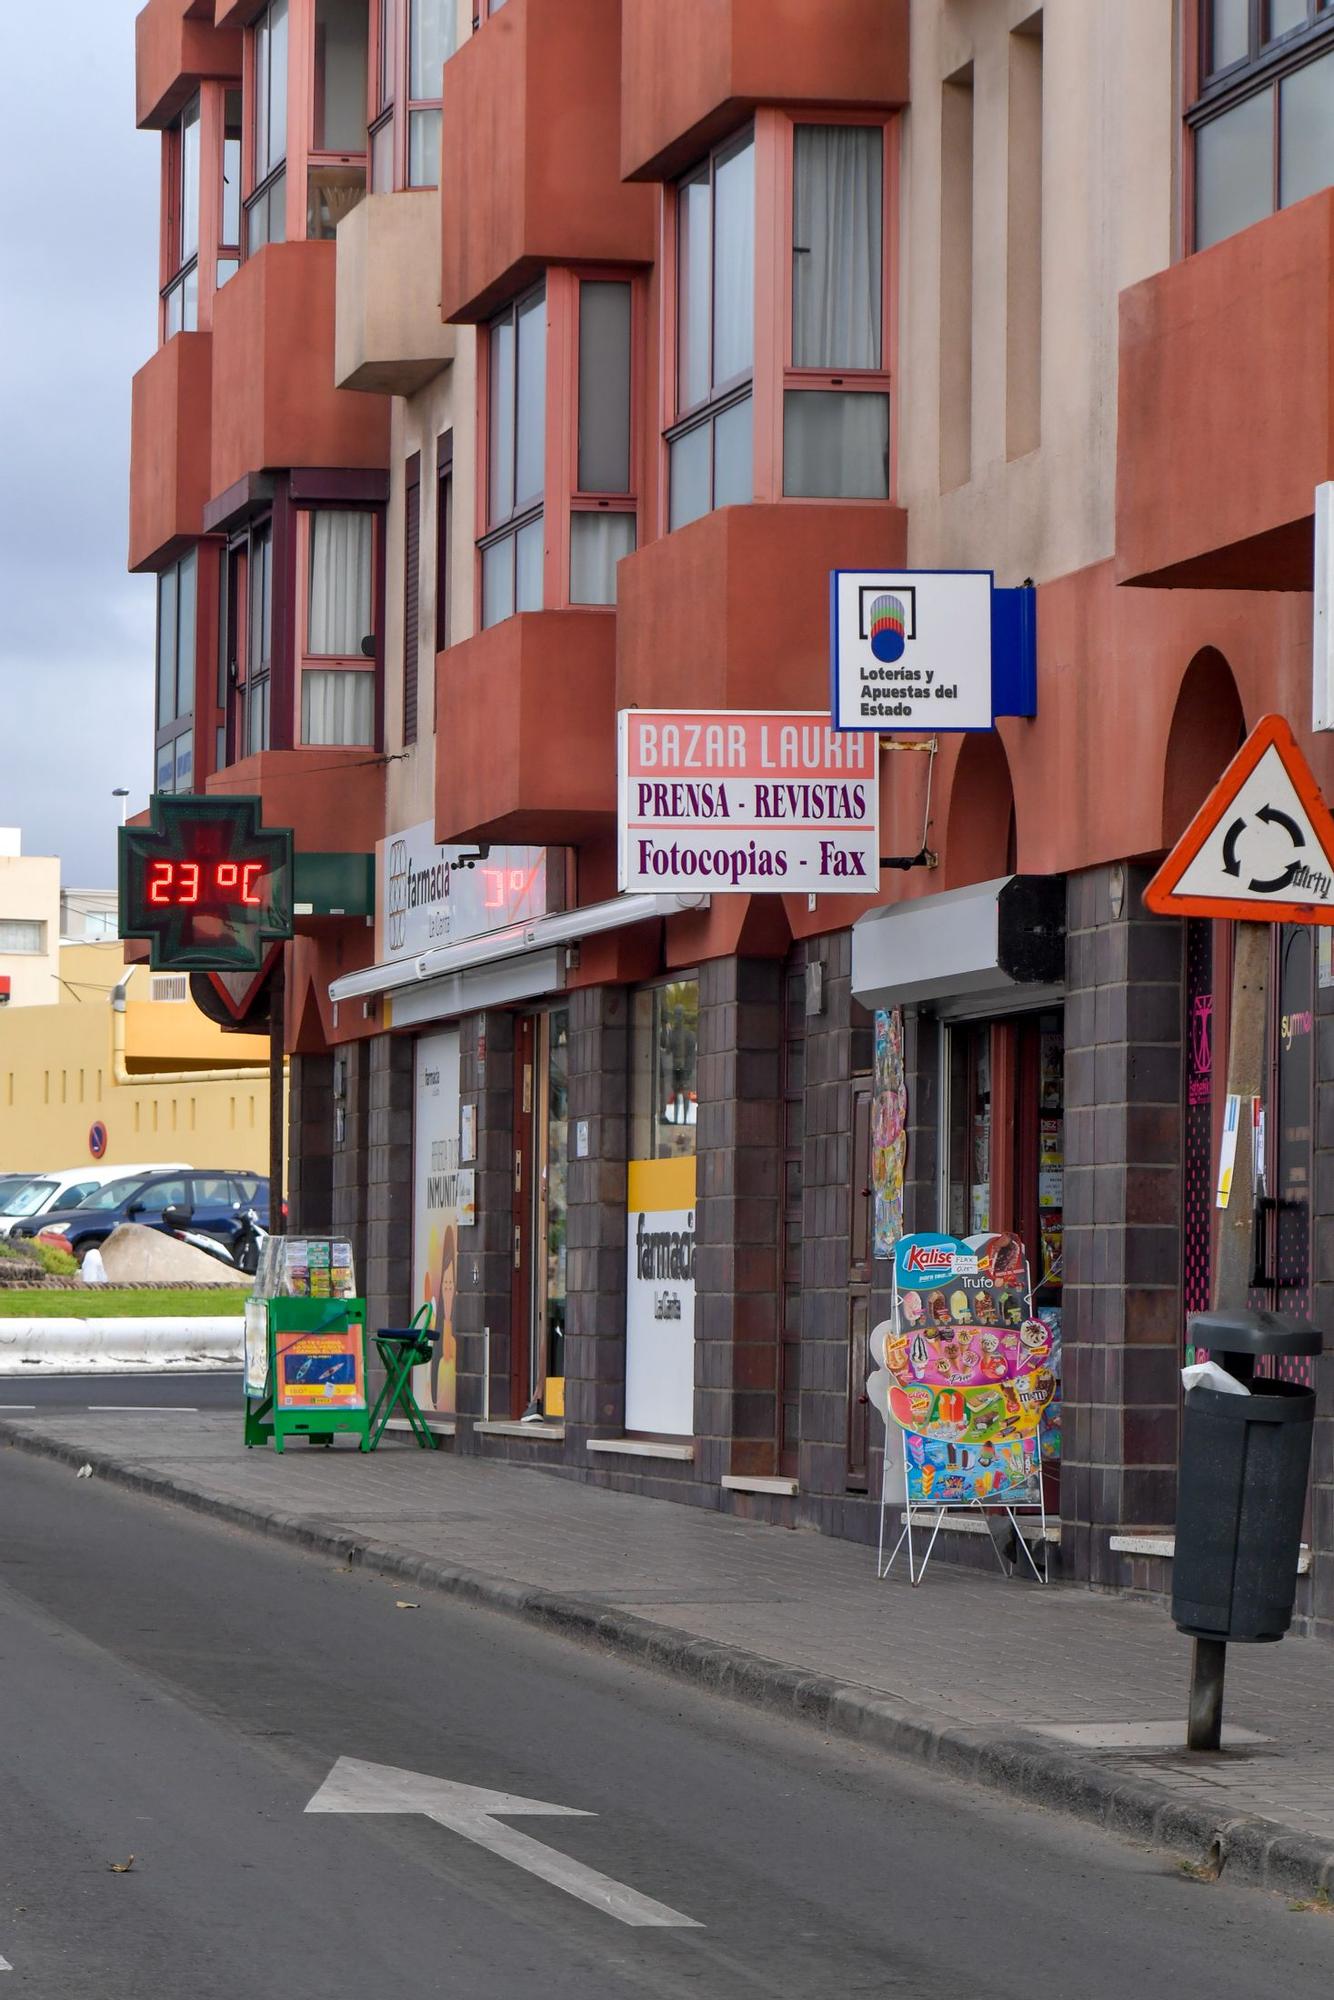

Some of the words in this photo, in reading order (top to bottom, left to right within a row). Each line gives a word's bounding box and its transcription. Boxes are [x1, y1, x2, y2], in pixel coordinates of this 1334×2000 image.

[860, 666, 921, 681] Loterías
[926, 670, 934, 684] y
[861, 685, 930, 701] Apuestas
[935, 685, 958, 699] del
[860, 702, 912, 716] Estado
[639, 725, 746, 768] BAZAR
[761, 725, 865, 769] LAURA
[637, 783, 730, 818] PRENSA
[754, 784, 866, 820] REVISTAS
[637, 840, 788, 885] Fotocopias
[818, 840, 867, 876] Fax
[151, 863, 198, 902] 23
[407, 848, 450, 909] farmacia
[907, 1245, 954, 1271] Kalise
[962, 1276, 994, 1288] Trufo
